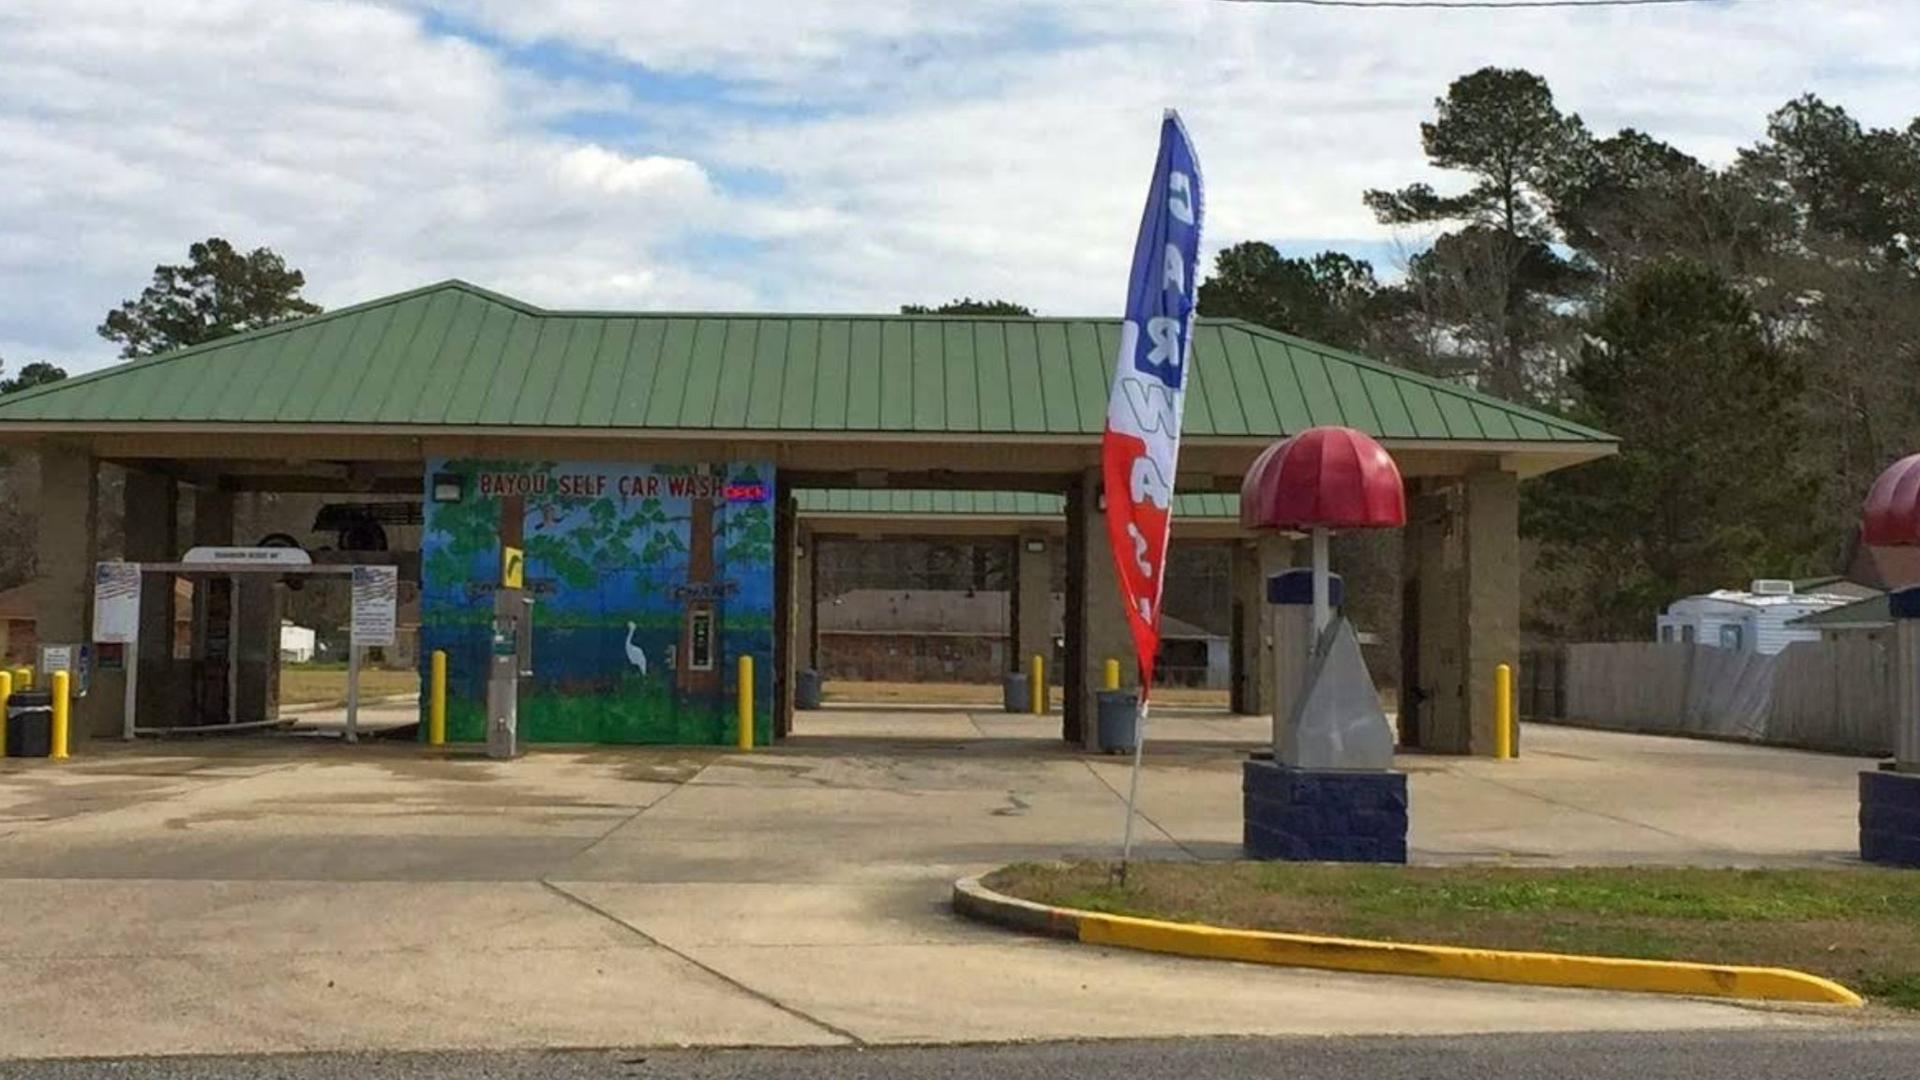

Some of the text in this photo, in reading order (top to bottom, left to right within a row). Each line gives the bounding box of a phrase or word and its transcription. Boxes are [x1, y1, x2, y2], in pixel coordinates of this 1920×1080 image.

[480, 473, 724, 497] BAYOU SELF CAR WASH
